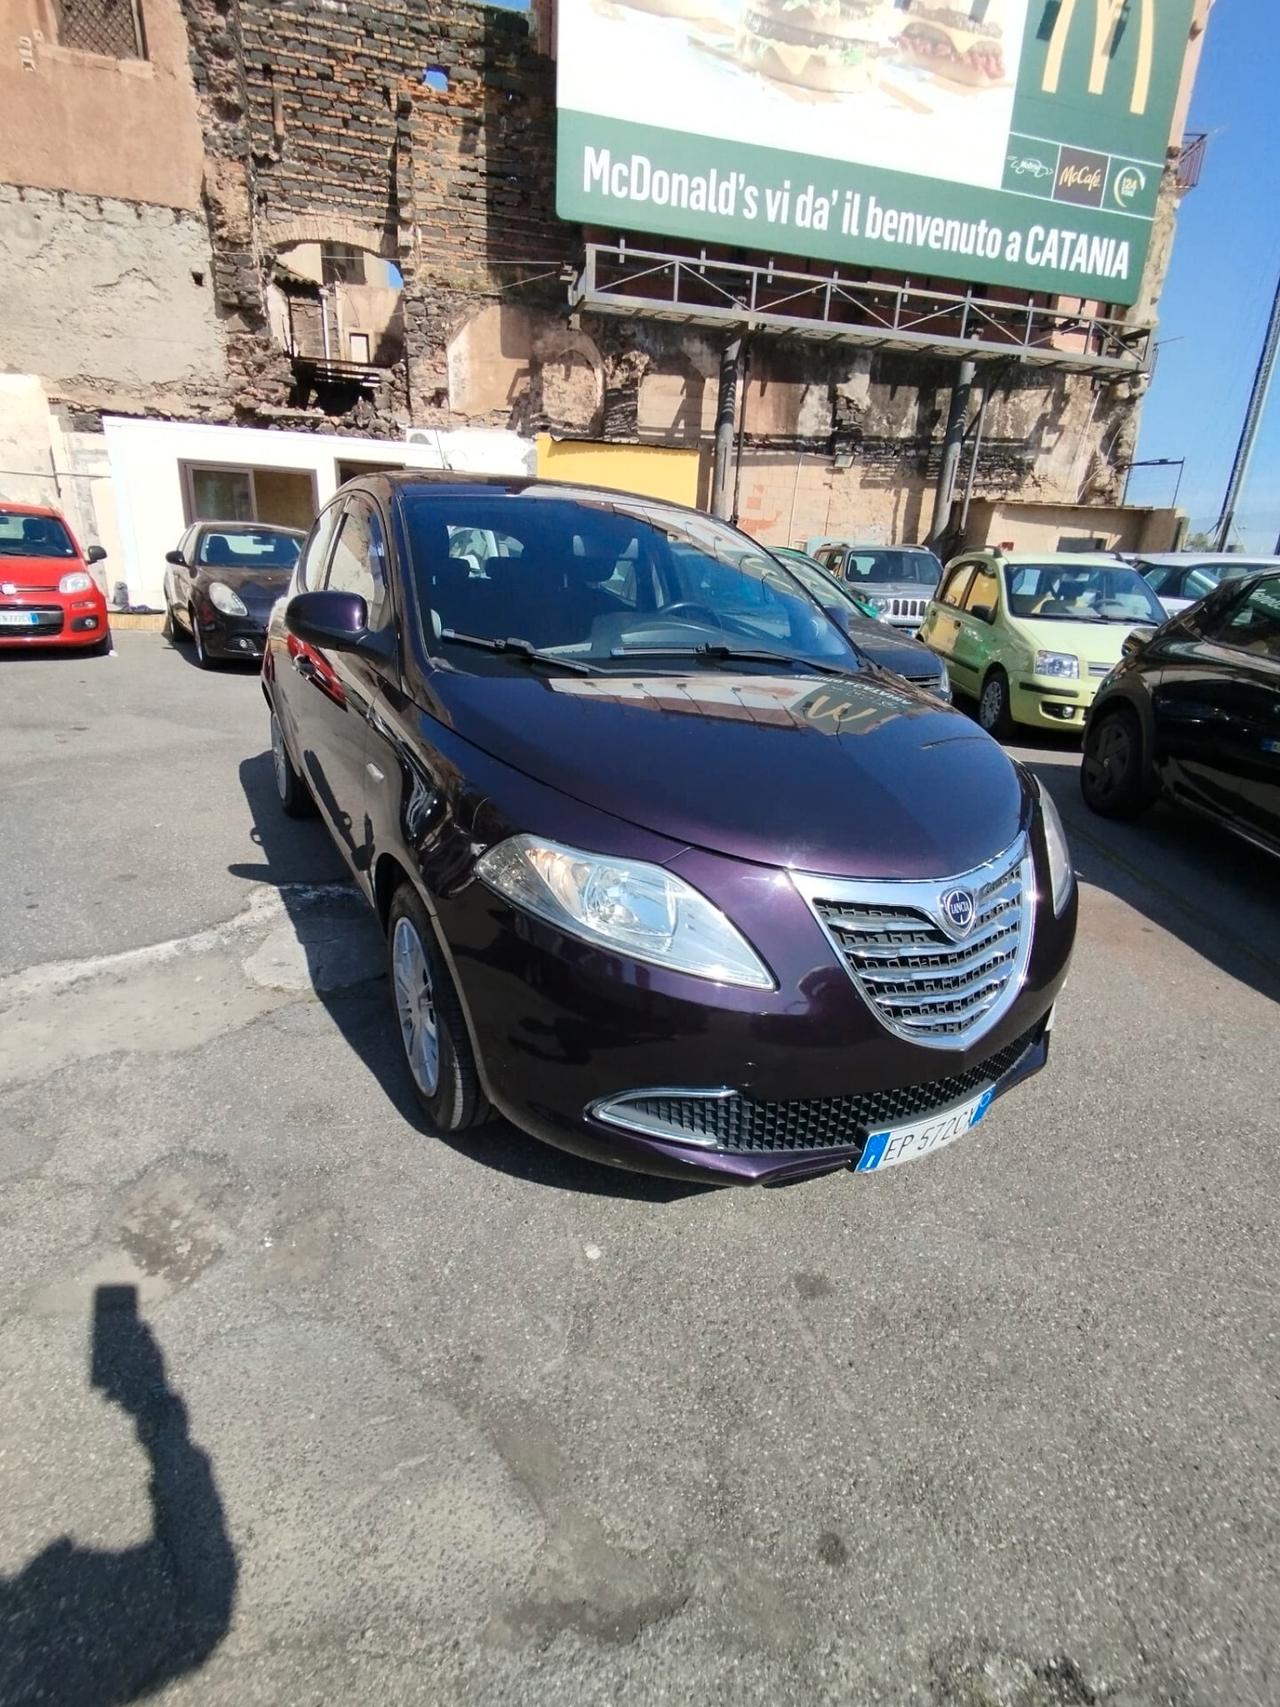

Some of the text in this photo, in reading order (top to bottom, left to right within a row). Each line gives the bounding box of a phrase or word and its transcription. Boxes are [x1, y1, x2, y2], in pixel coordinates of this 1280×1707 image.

[583, 145, 1130, 280] McDonald's vi da' il benvenuto a CATANIA
[884, 1134, 915, 1161] EP
